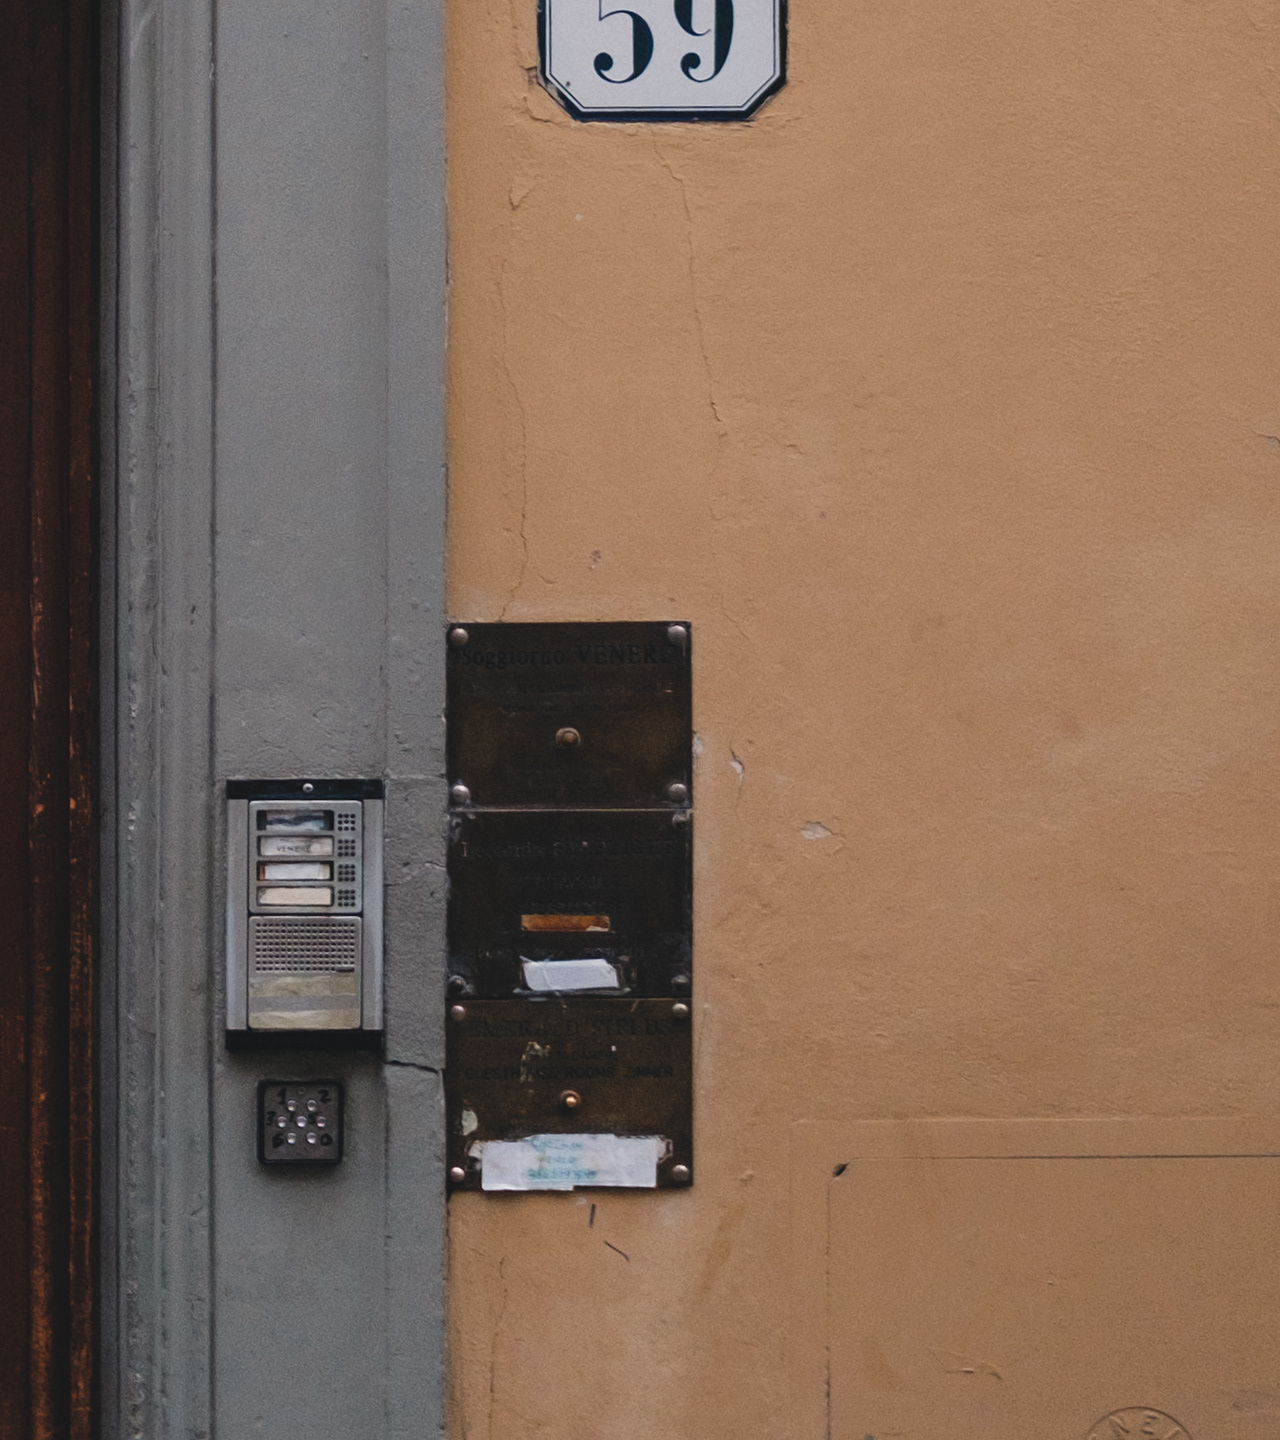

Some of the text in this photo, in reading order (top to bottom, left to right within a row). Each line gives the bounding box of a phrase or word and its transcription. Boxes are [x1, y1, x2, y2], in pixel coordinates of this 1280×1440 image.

[461, 643, 675, 669] Soggiorno VENERE
[318, 1089, 331, 1104] 2
[320, 1133, 333, 1146] 0
